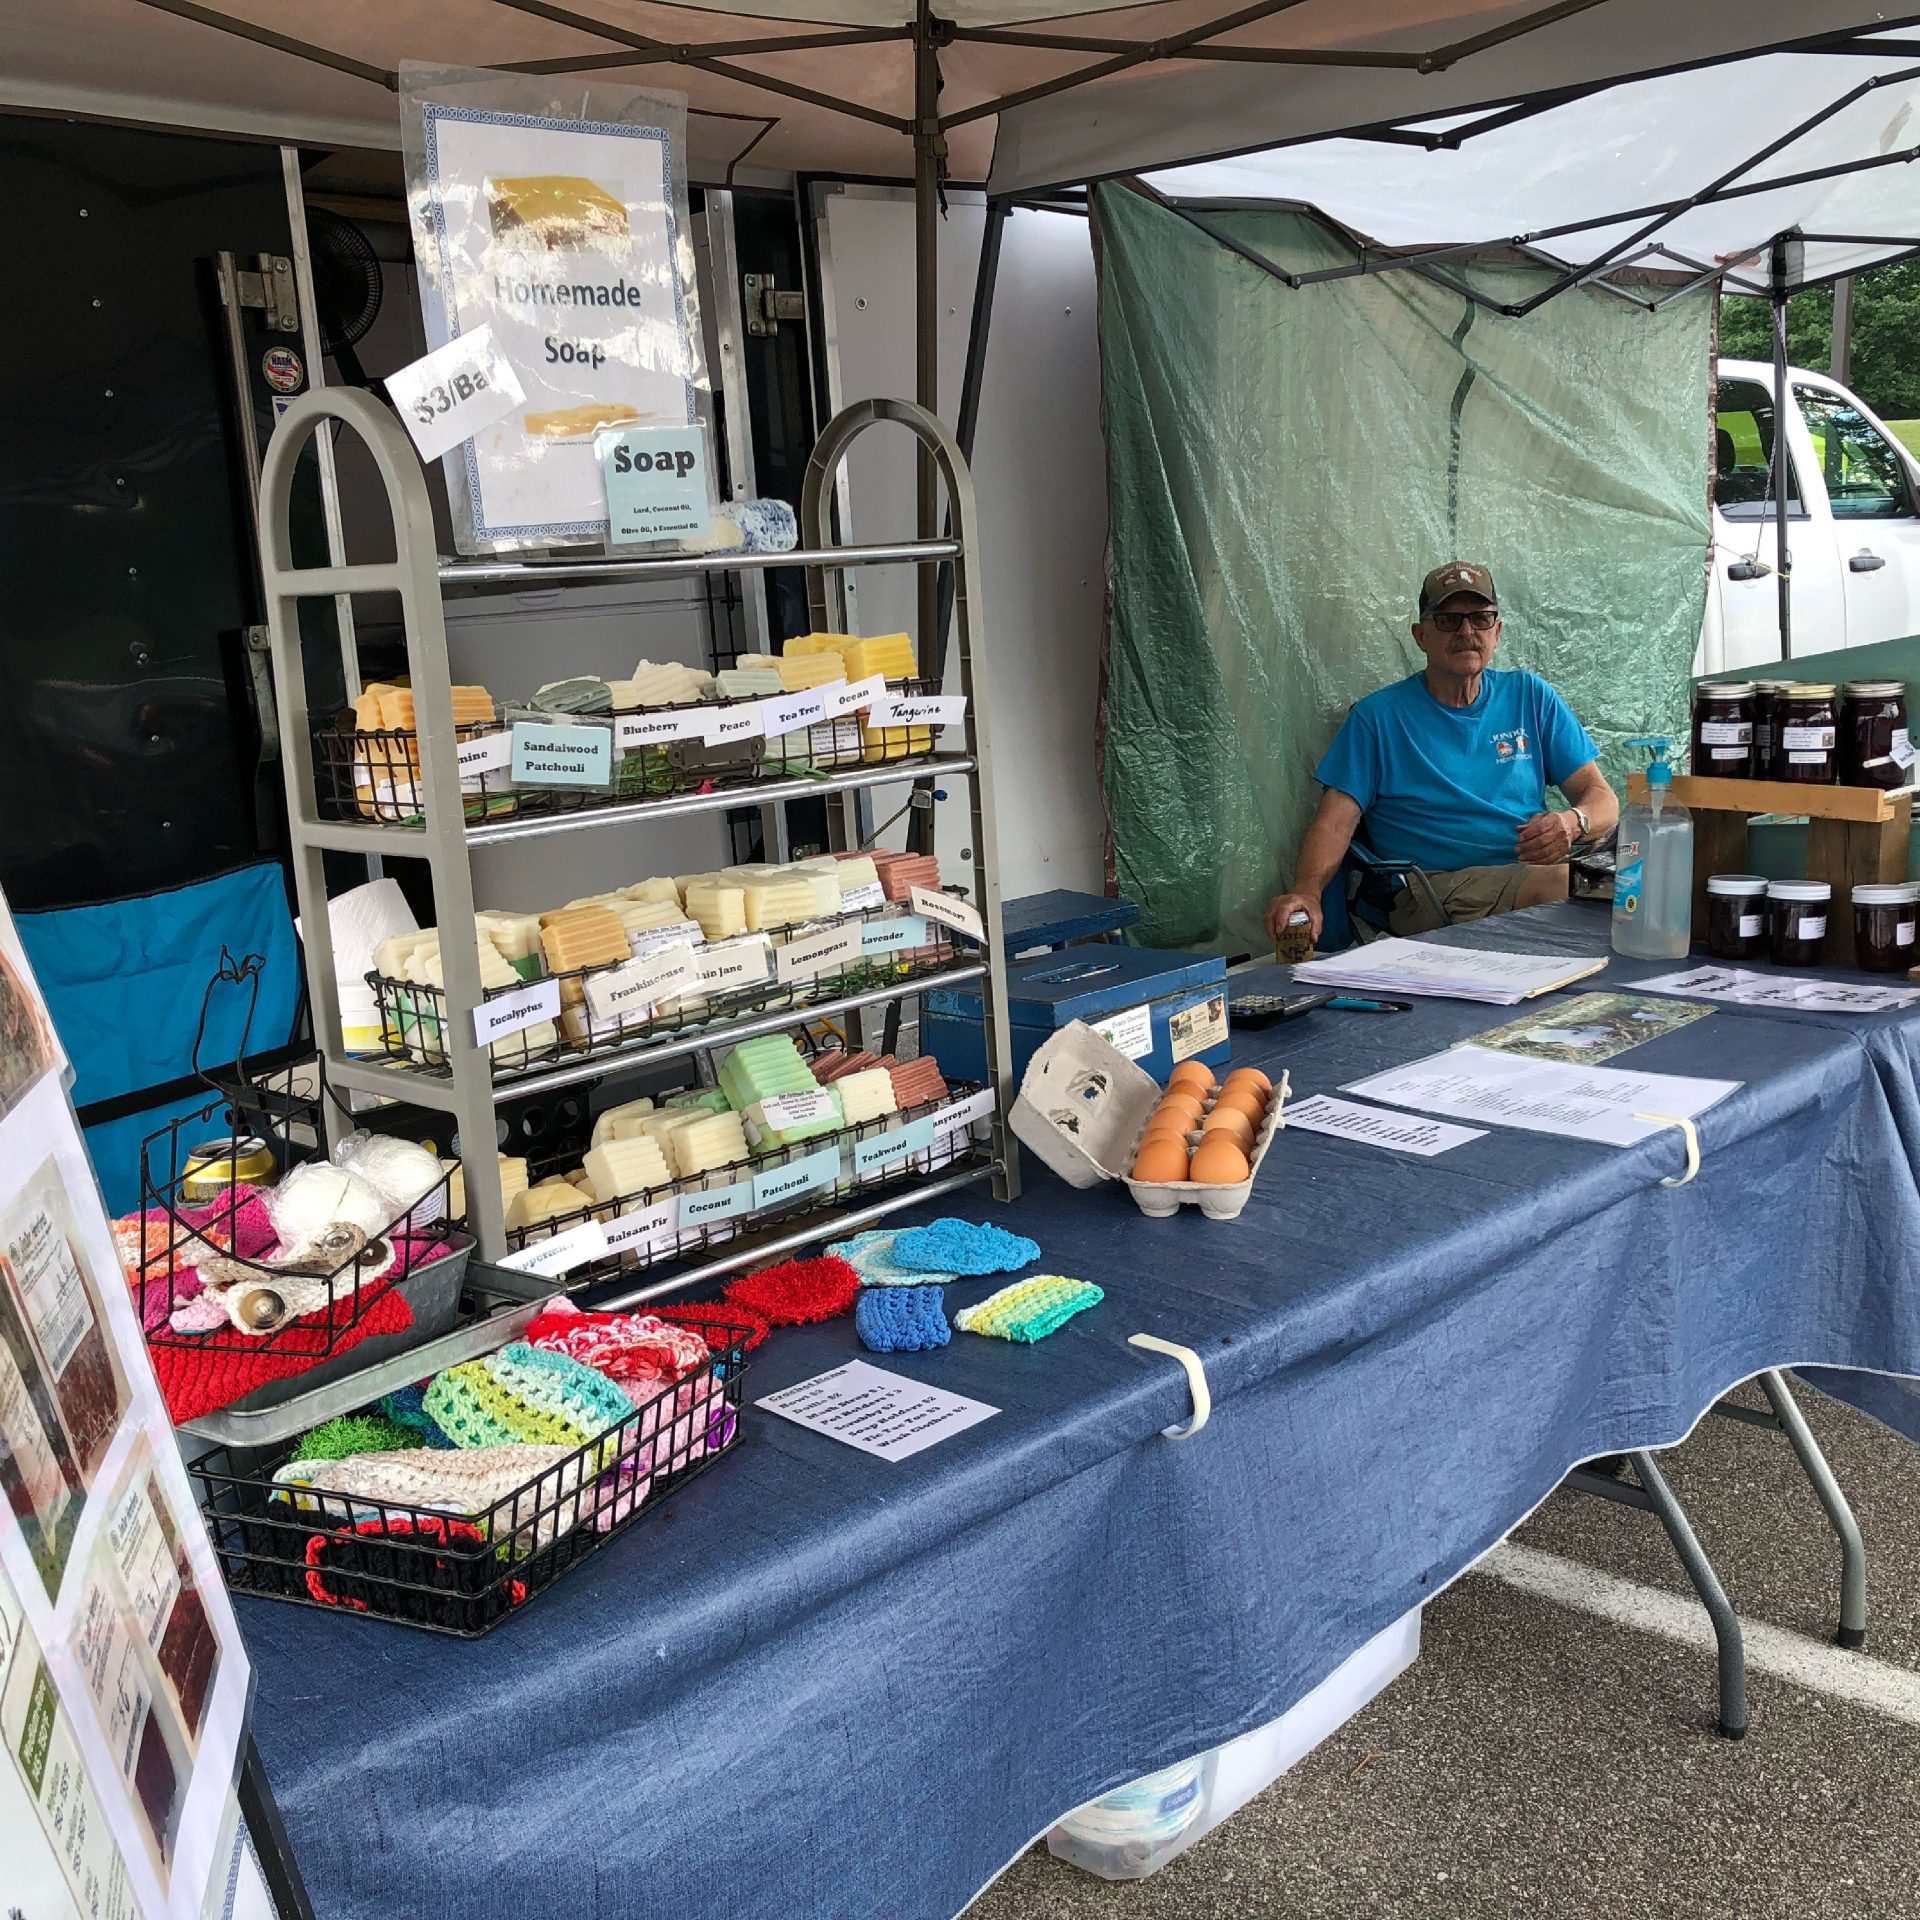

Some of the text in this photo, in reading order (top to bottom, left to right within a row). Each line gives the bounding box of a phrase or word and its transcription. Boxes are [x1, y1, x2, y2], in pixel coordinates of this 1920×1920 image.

[495, 276, 641, 307] Homemade
[544, 336, 607, 370] Soap
[413, 370, 489, 425] $3/Ba
[614, 445, 696, 478] Soap
[838, 688, 870, 706] Ocean
[778, 703, 821, 723] Tea Tree
[890, 704, 942, 722] Tangerine
[622, 720, 679, 736] Blueberry
[719, 718, 752, 733] Peace
[458, 751, 488, 765] mine
[523, 741, 599, 755] Sandalwood
[525, 761, 585, 773] Patchouli
[921, 898, 966, 922] Rosemary
[861, 931, 905, 945] Lavender
[791, 939, 848, 966] Lemongrass
[718, 963, 743, 979] Jane
[609, 965, 686, 1002] Frankincense
[489, 1001, 544, 1028] Eucalyptus
[861, 1140, 908, 1163] Teakwood
[761, 1174, 810, 1198] Patchouli
[688, 1197, 732, 1214] Coconut
[606, 1225, 650, 1245] Balsam
[652, 1216, 668, 1230] Fir
